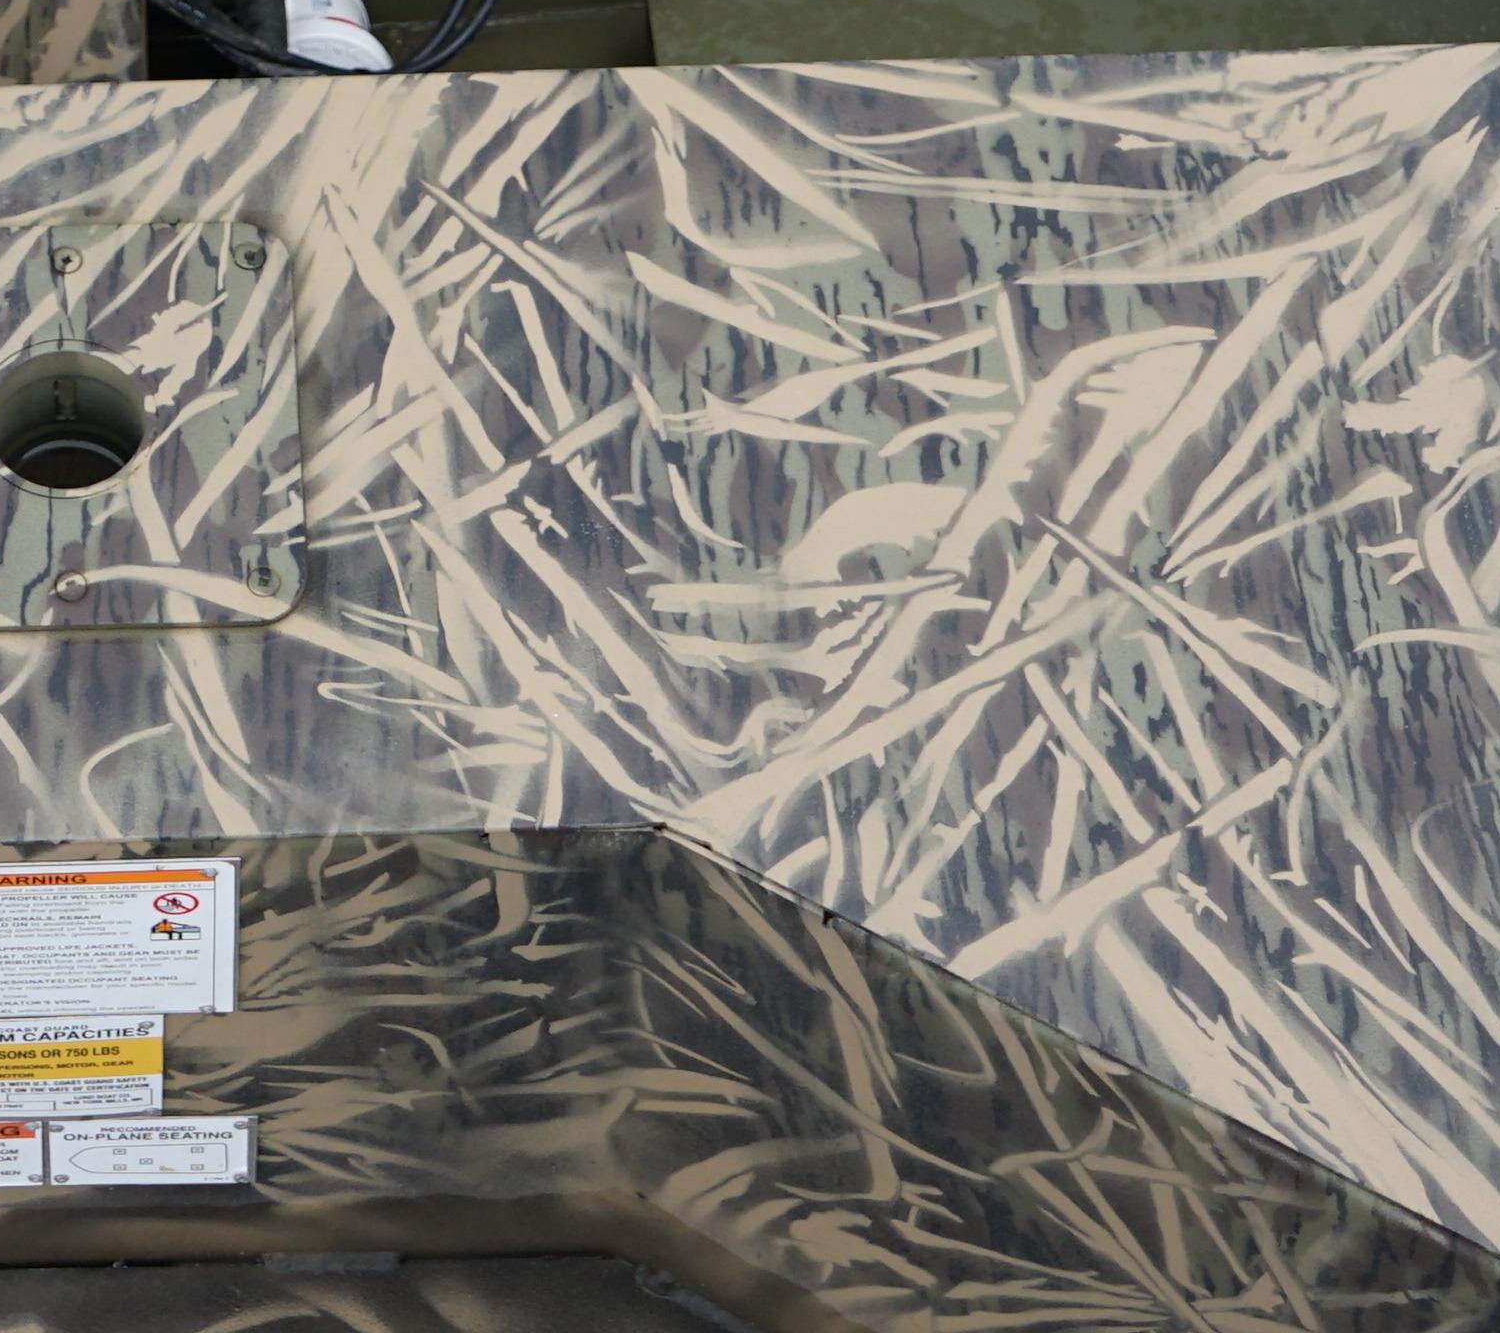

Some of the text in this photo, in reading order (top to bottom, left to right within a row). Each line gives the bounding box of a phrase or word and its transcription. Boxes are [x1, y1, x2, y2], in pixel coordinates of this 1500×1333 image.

[22, 1027, 150, 1042] CAPACITIES
[40, 1049, 61, 1059] OR
[65, 1048, 89, 1057] 750
[92, 1046, 121, 1056] LBS
[63, 1132, 233, 1141] ON-PLANE SEATING
